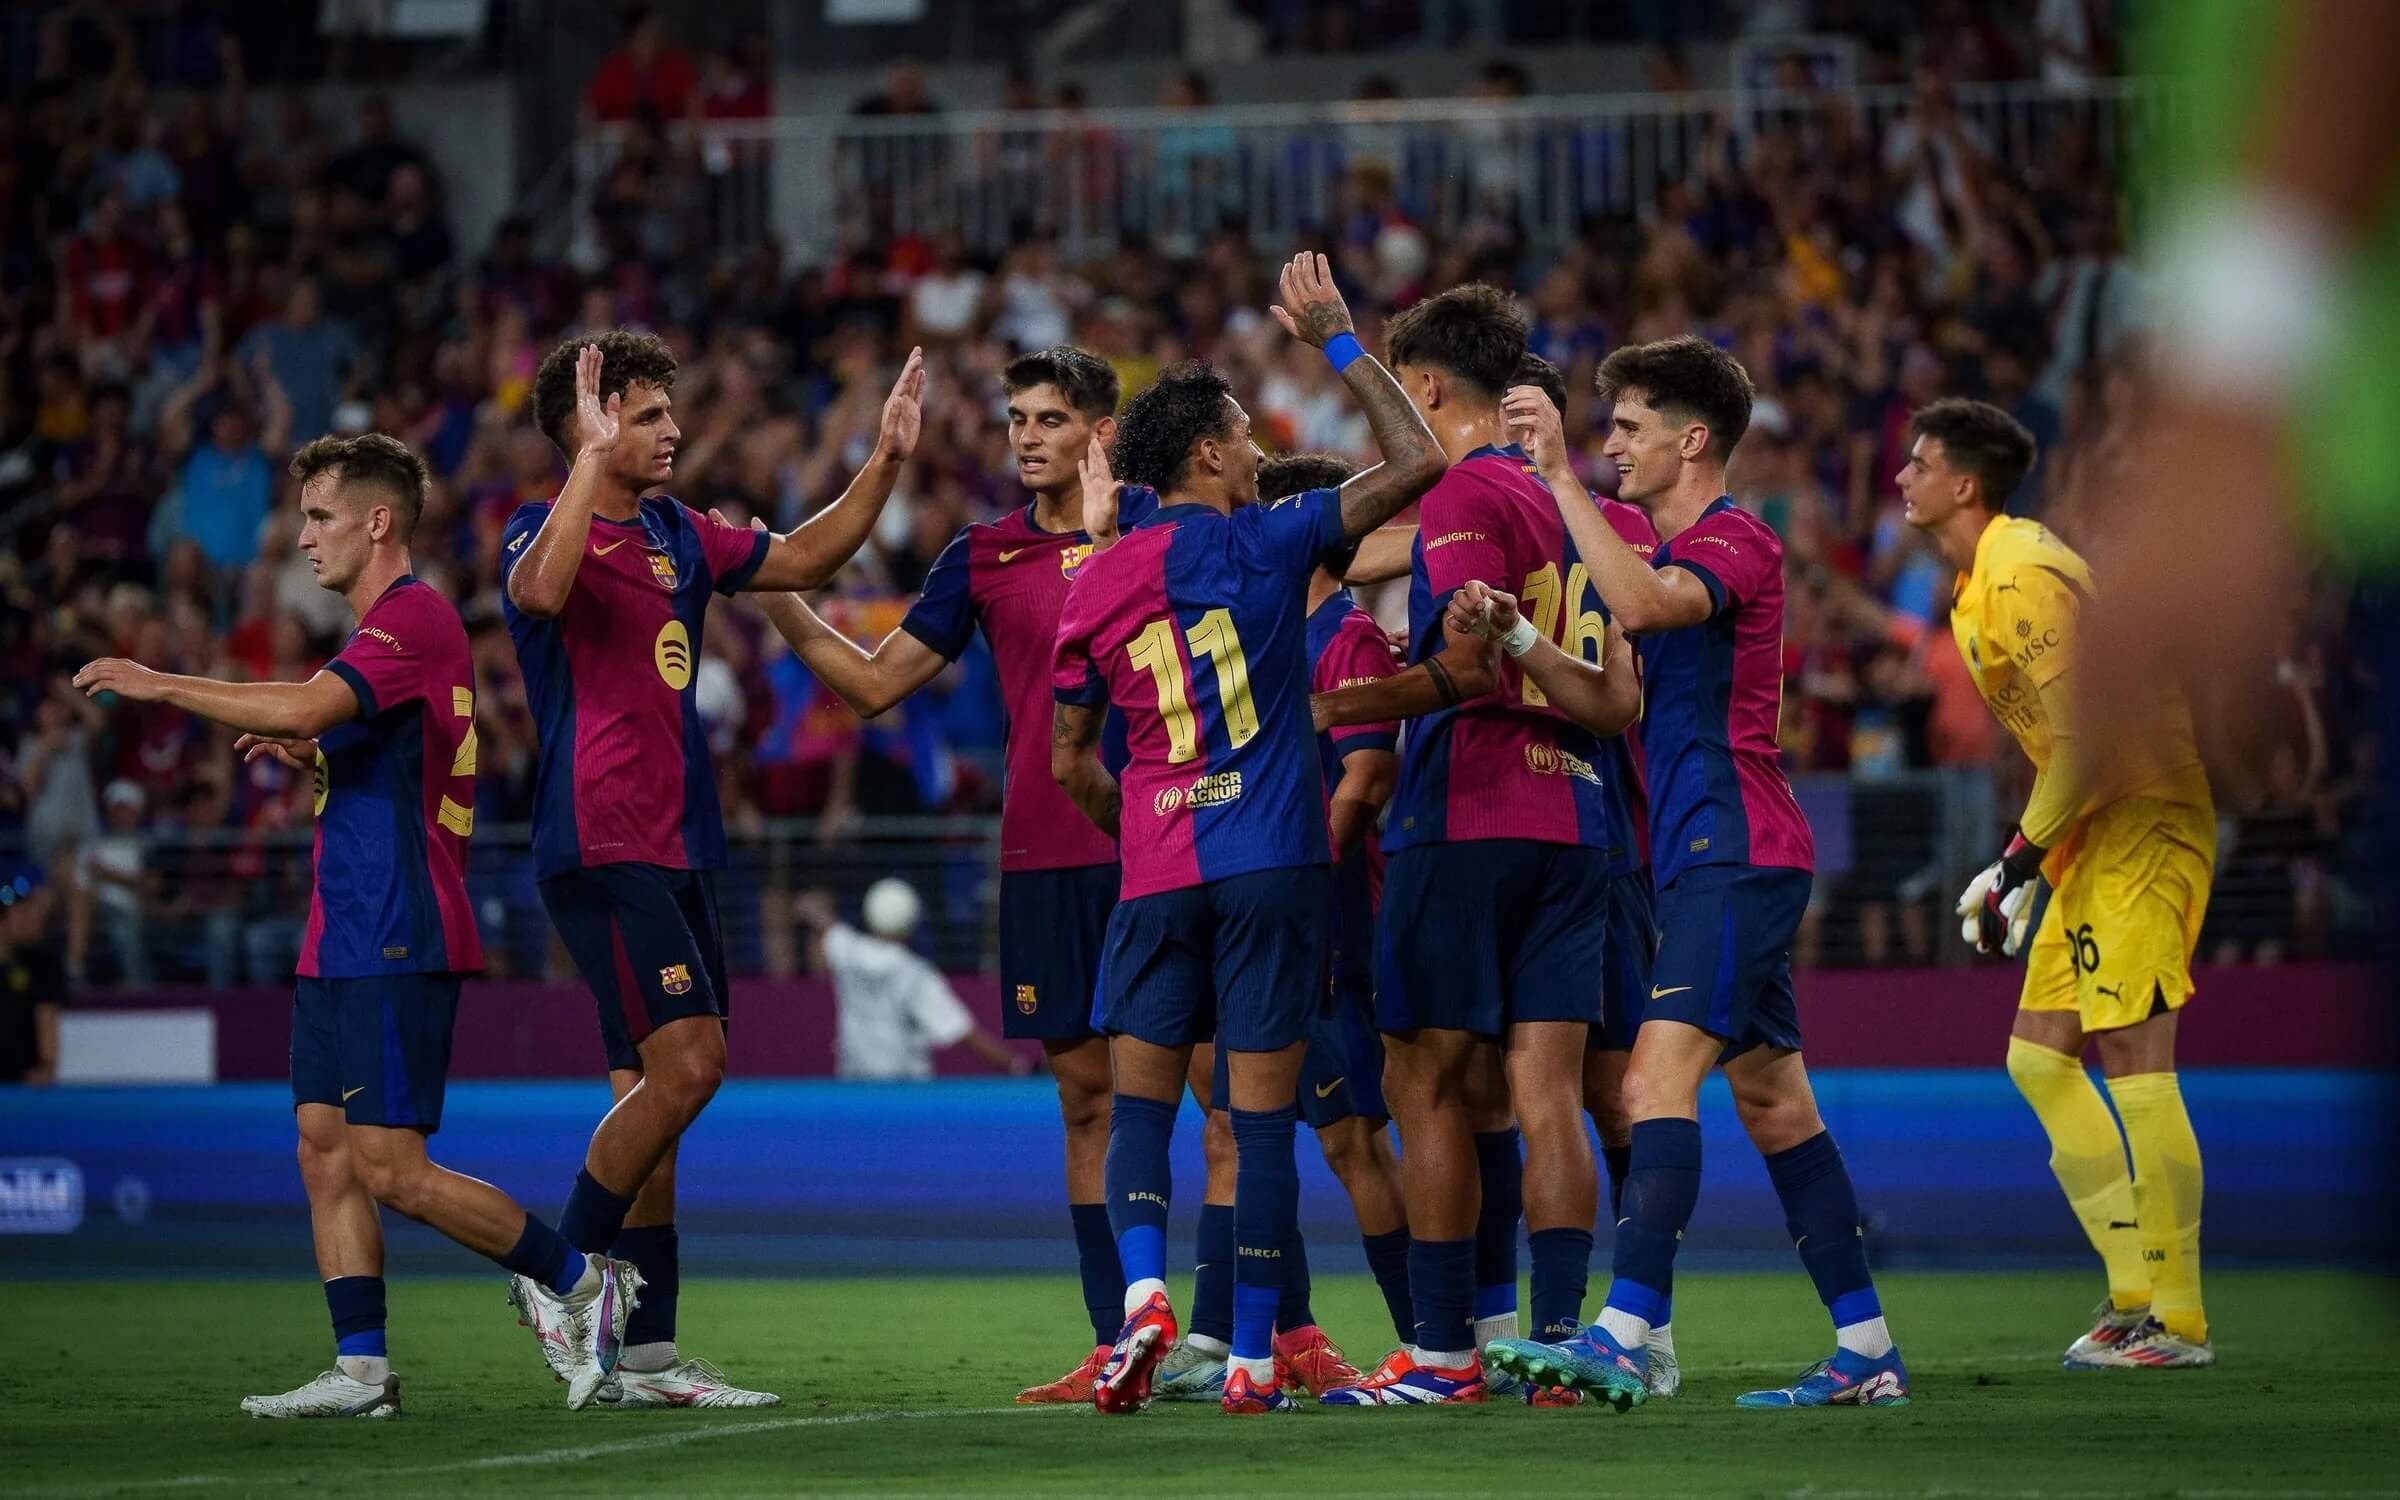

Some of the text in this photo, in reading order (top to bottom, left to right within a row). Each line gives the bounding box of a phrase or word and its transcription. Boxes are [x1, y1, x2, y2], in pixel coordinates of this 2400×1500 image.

[1426, 532, 1473, 551] AMBILIGHT
[1521, 561, 1606, 707] 16
[2016, 628, 2060, 668] MSC
[1126, 608, 1260, 764] 11
[1186, 784, 1242, 803] ACNUR
